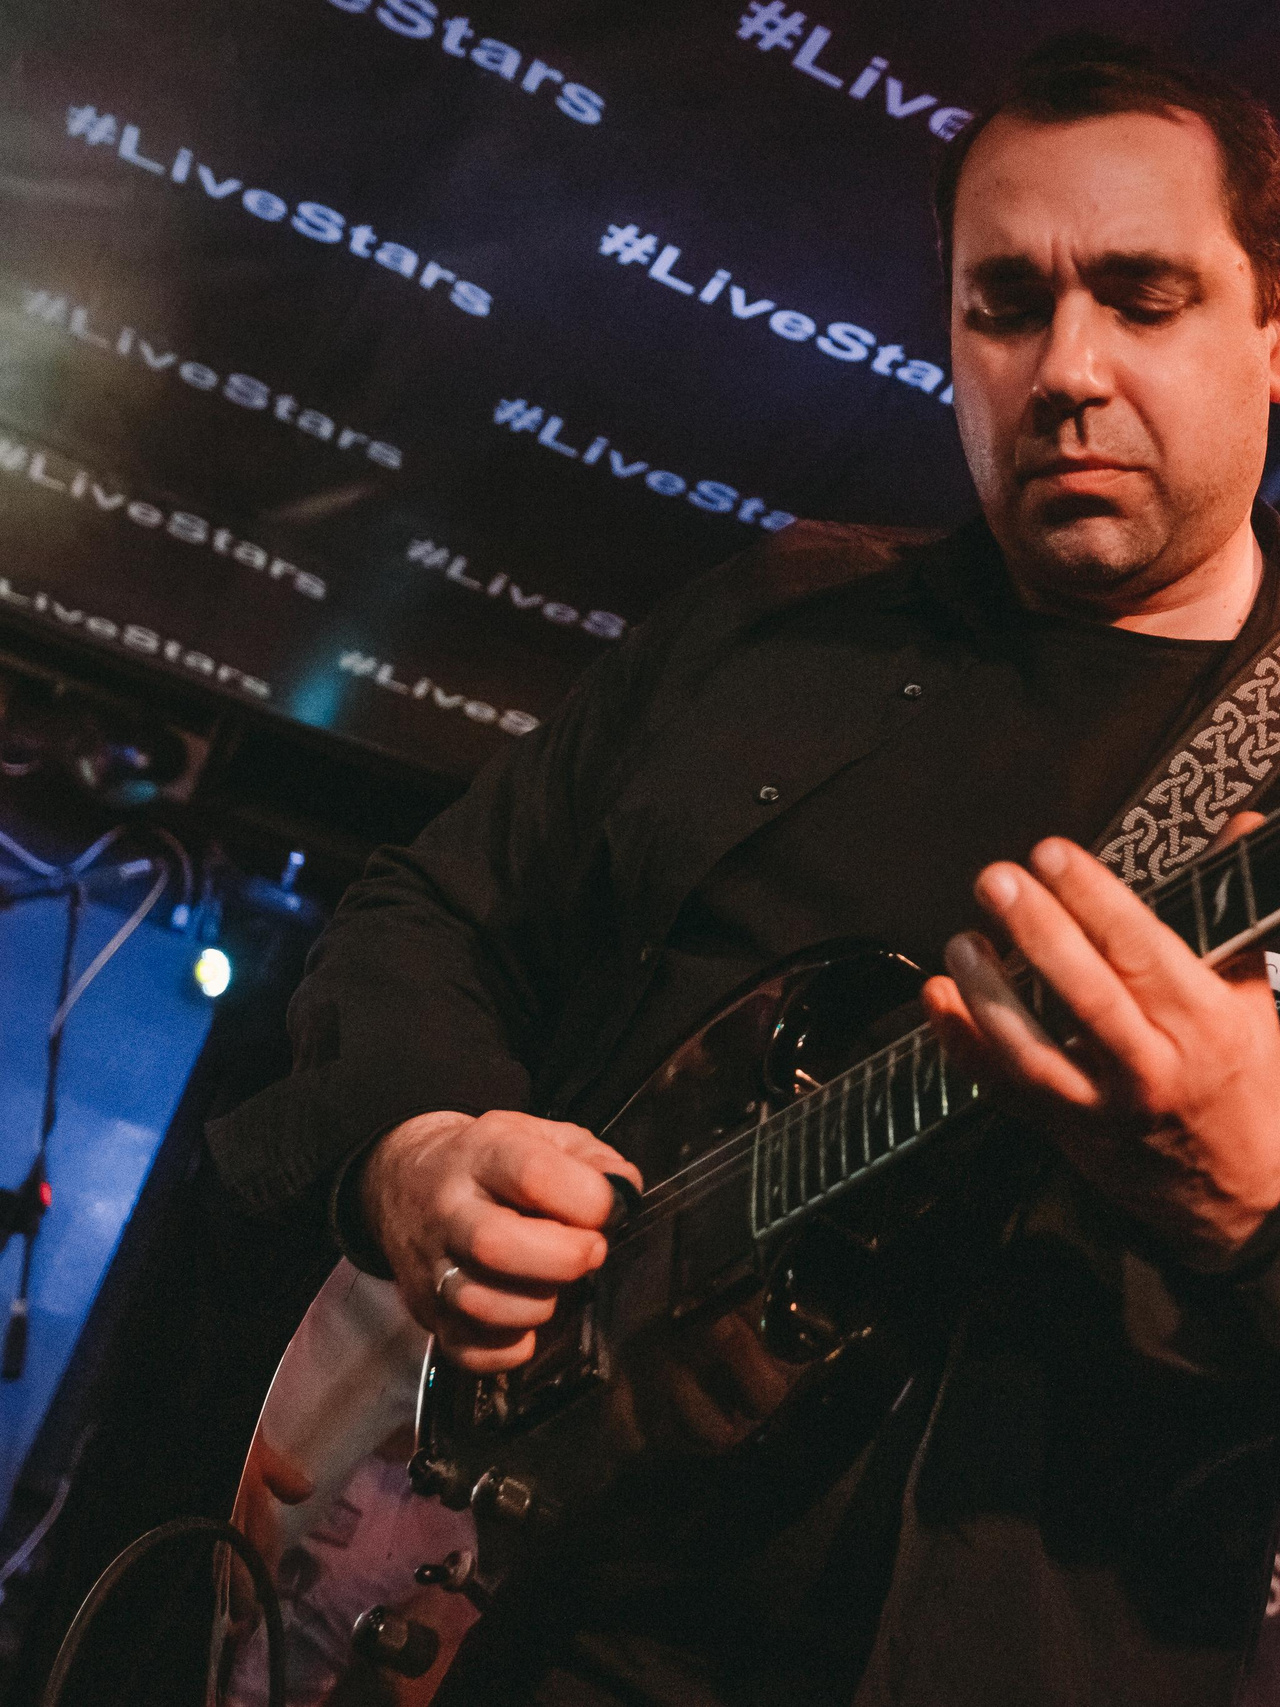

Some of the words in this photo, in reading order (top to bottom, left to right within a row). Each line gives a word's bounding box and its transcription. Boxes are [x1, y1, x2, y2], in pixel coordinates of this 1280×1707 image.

[66, 104, 493, 317] #LiveStars
[24, 290, 402, 470] #LiveStars
[599, 224, 954, 404] #LiveSta
